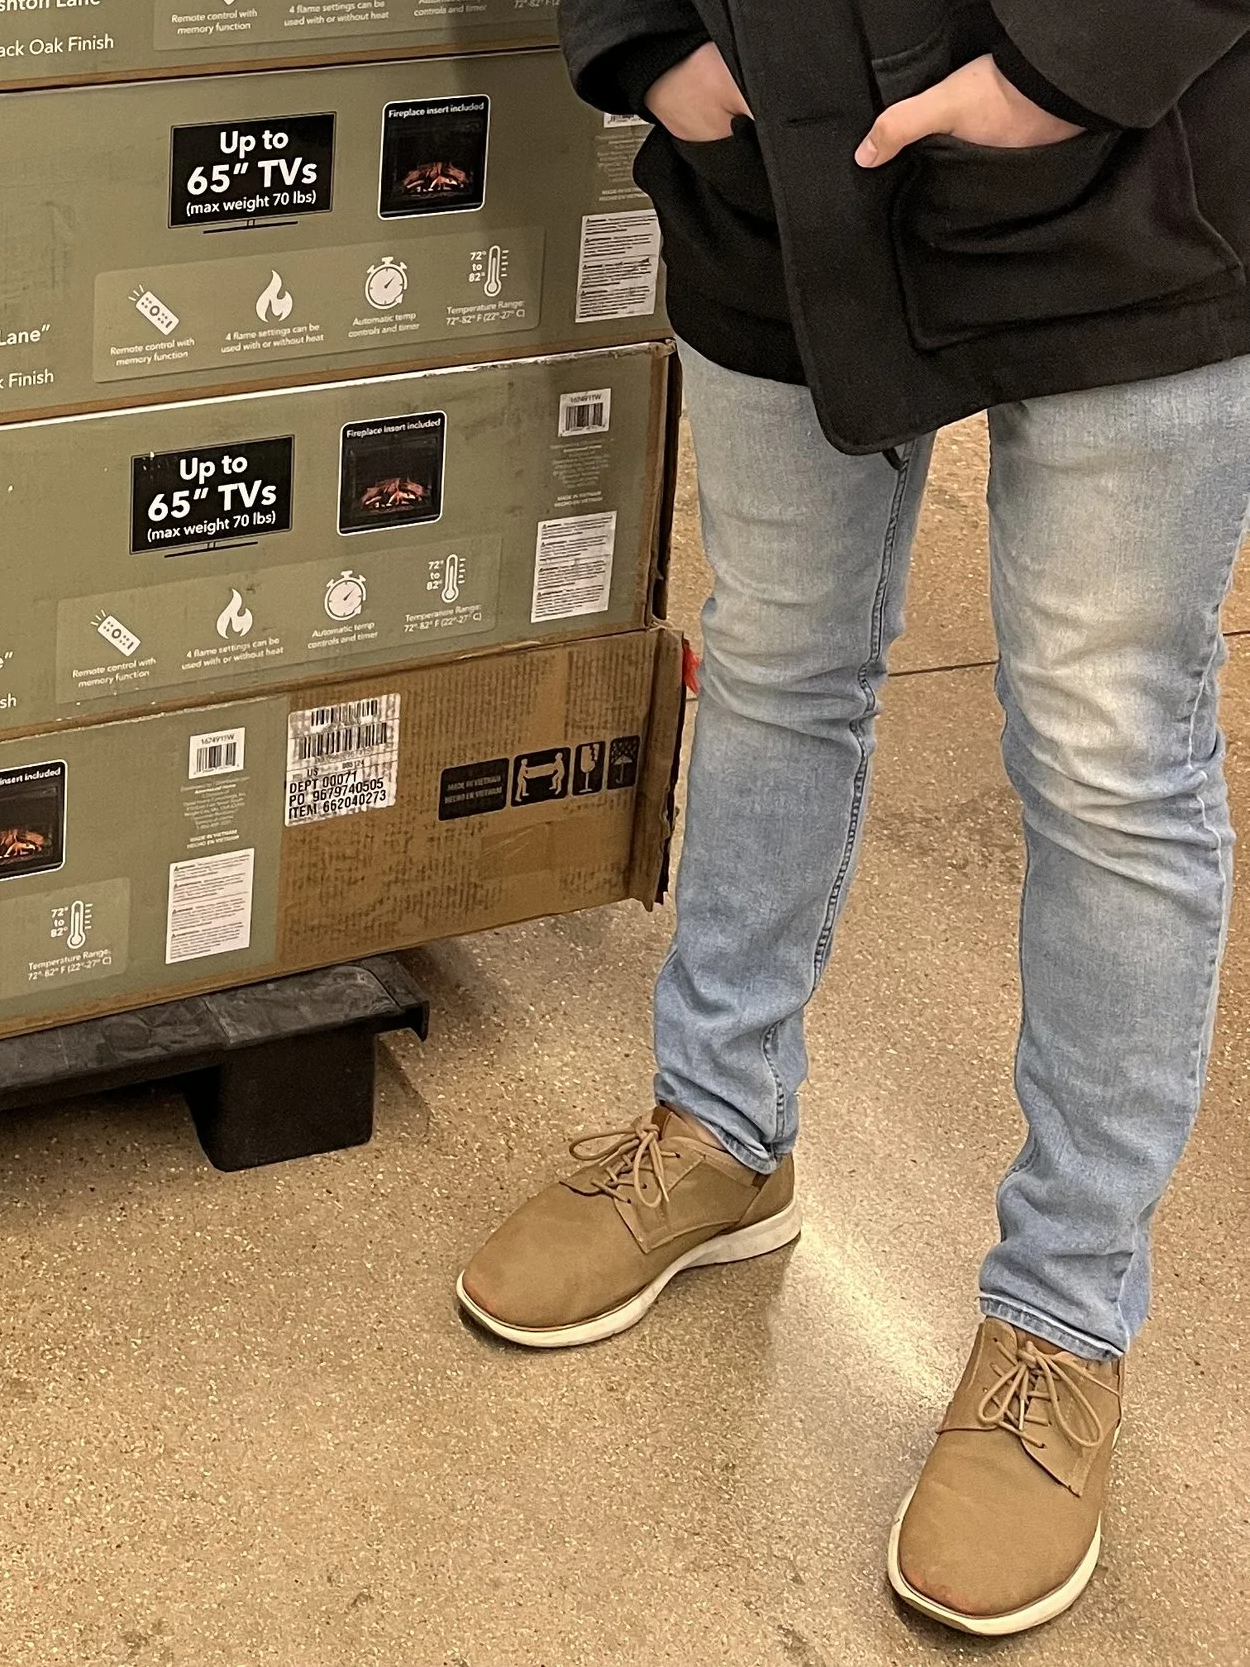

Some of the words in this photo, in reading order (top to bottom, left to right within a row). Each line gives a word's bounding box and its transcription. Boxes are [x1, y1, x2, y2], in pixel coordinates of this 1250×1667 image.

[30, 38, 63, 54] Oak
[68, 34, 113, 51] Finish
[221, 131, 255, 158] Up
[262, 130, 288, 149] to
[258, 157, 317, 187] TVs
[187, 202, 219, 216] (max
[223, 195, 269, 212] weight
[273, 192, 289, 206] 70
[293, 190, 316, 208] lbs)
[110, 343, 145, 356] Remote
[148, 340, 179, 352] control
[181, 337, 195, 349] with
[116, 354, 152, 368] memory
[154, 350, 188, 363] function
[180, 458, 215, 484] Up
[222, 456, 247, 474] to
[218, 480, 276, 514] TVs
[148, 523, 180, 542] (max
[184, 518, 229, 535] weight
[233, 515, 249, 528] 70
[253, 511, 275, 525] lbs)
[0, 775, 23, 785] insert
[25, 767, 61, 781] included
[290, 779, 318, 793] DEPT
[322, 771, 357, 787] 00071
[289, 804, 317, 819] ITEM
[323, 790, 386, 812] 662040273
[290, 795, 305, 806] PO
[313, 778, 384, 802] 9679740505
